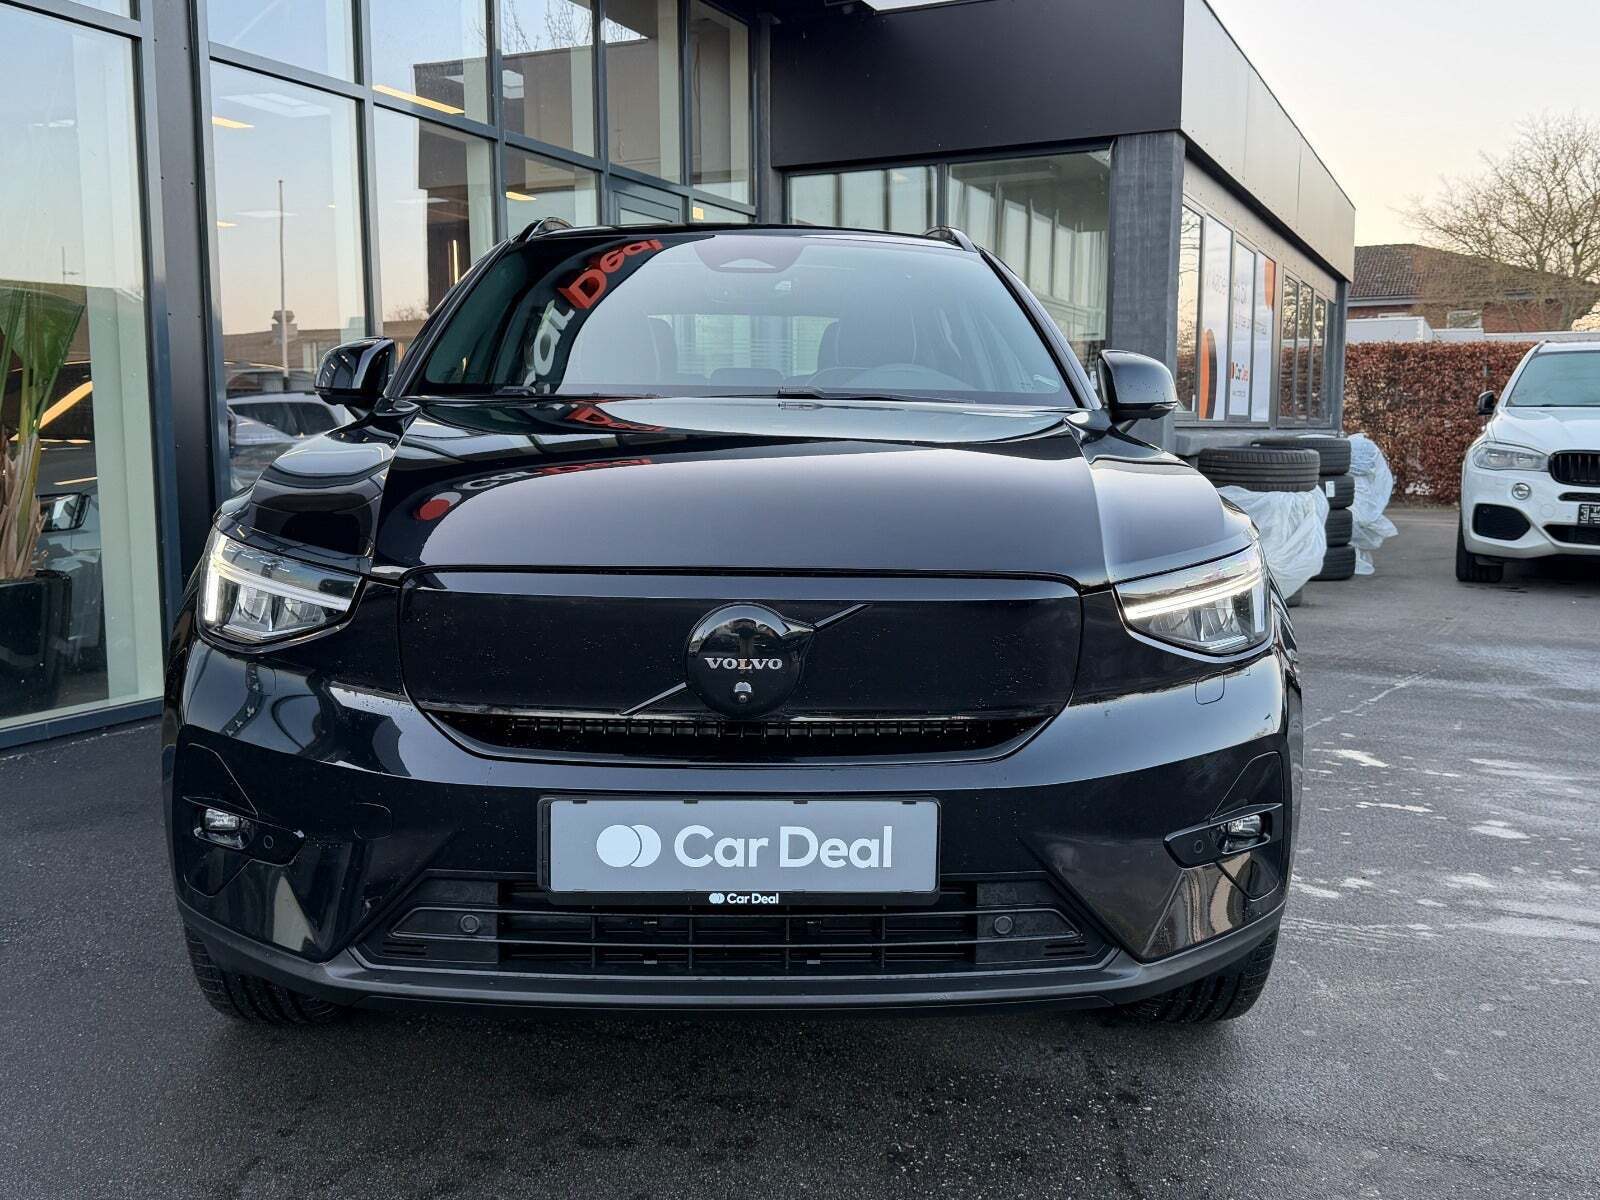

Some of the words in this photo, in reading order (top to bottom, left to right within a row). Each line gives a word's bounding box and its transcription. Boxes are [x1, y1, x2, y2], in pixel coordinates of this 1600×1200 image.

[704, 657, 783, 670] VOLVO
[673, 825, 769, 869] Car
[779, 825, 894, 869] Deal
[726, 892, 750, 905] Car
[751, 892, 779, 905] Deal
